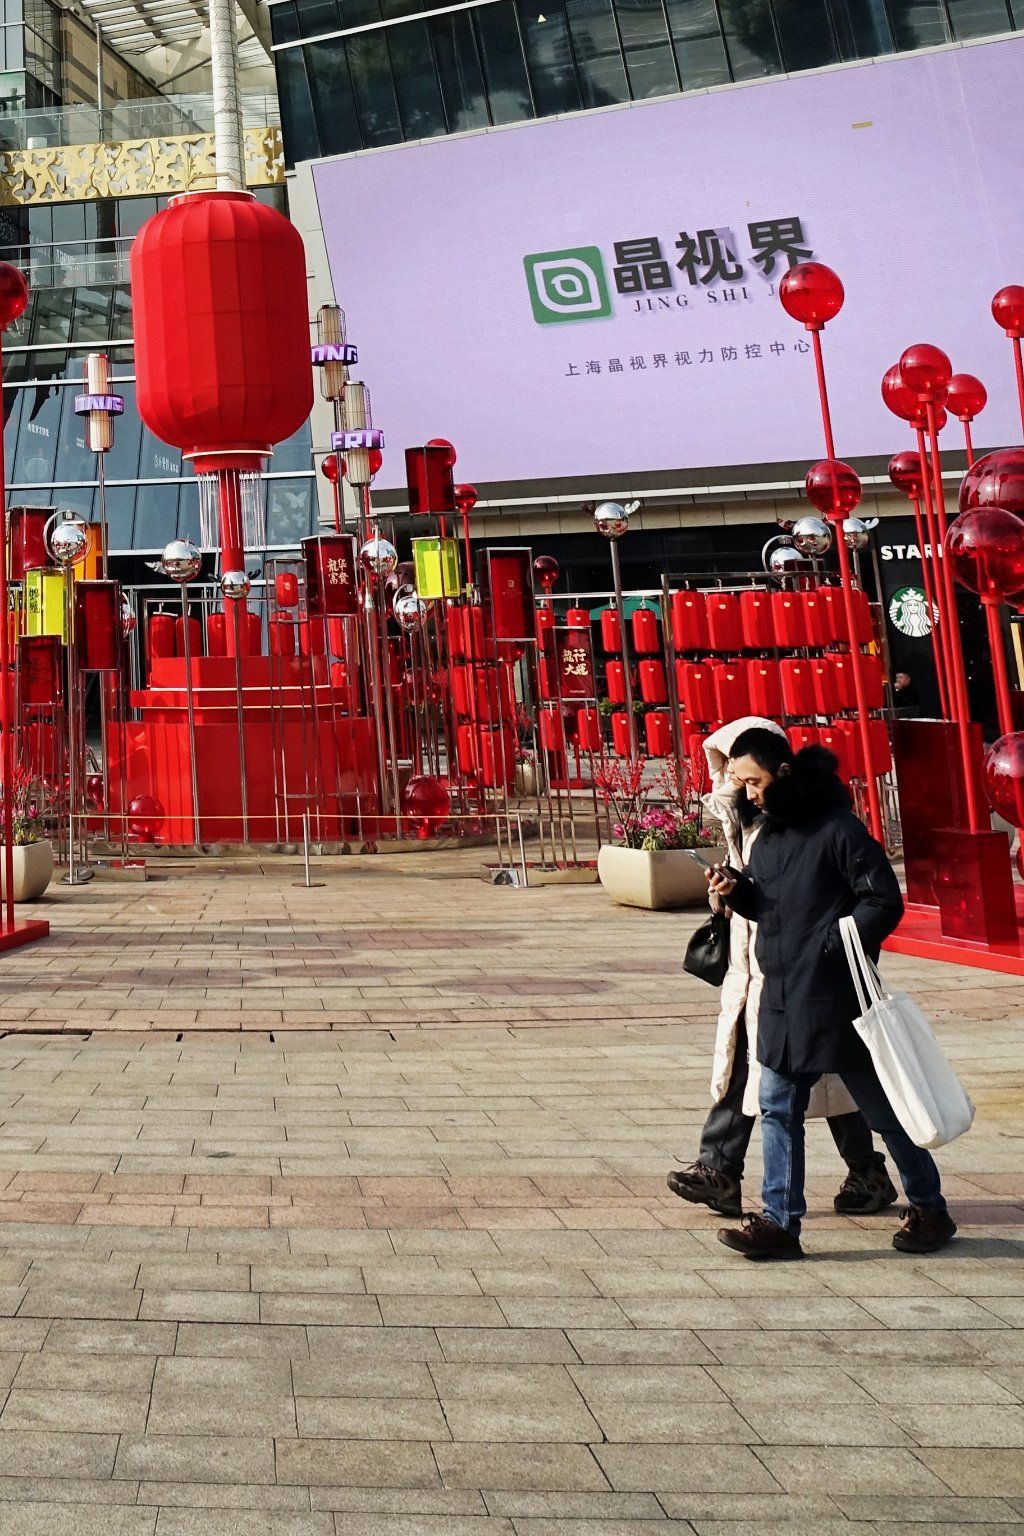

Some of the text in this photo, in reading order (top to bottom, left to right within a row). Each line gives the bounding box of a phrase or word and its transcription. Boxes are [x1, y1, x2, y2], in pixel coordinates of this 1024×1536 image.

[613, 216, 813, 294] 晶视界
[634, 294, 689, 313] JING
[707, 286, 749, 304] SHI
[564, 339, 813, 378] 上海晶视界视力防控中心
